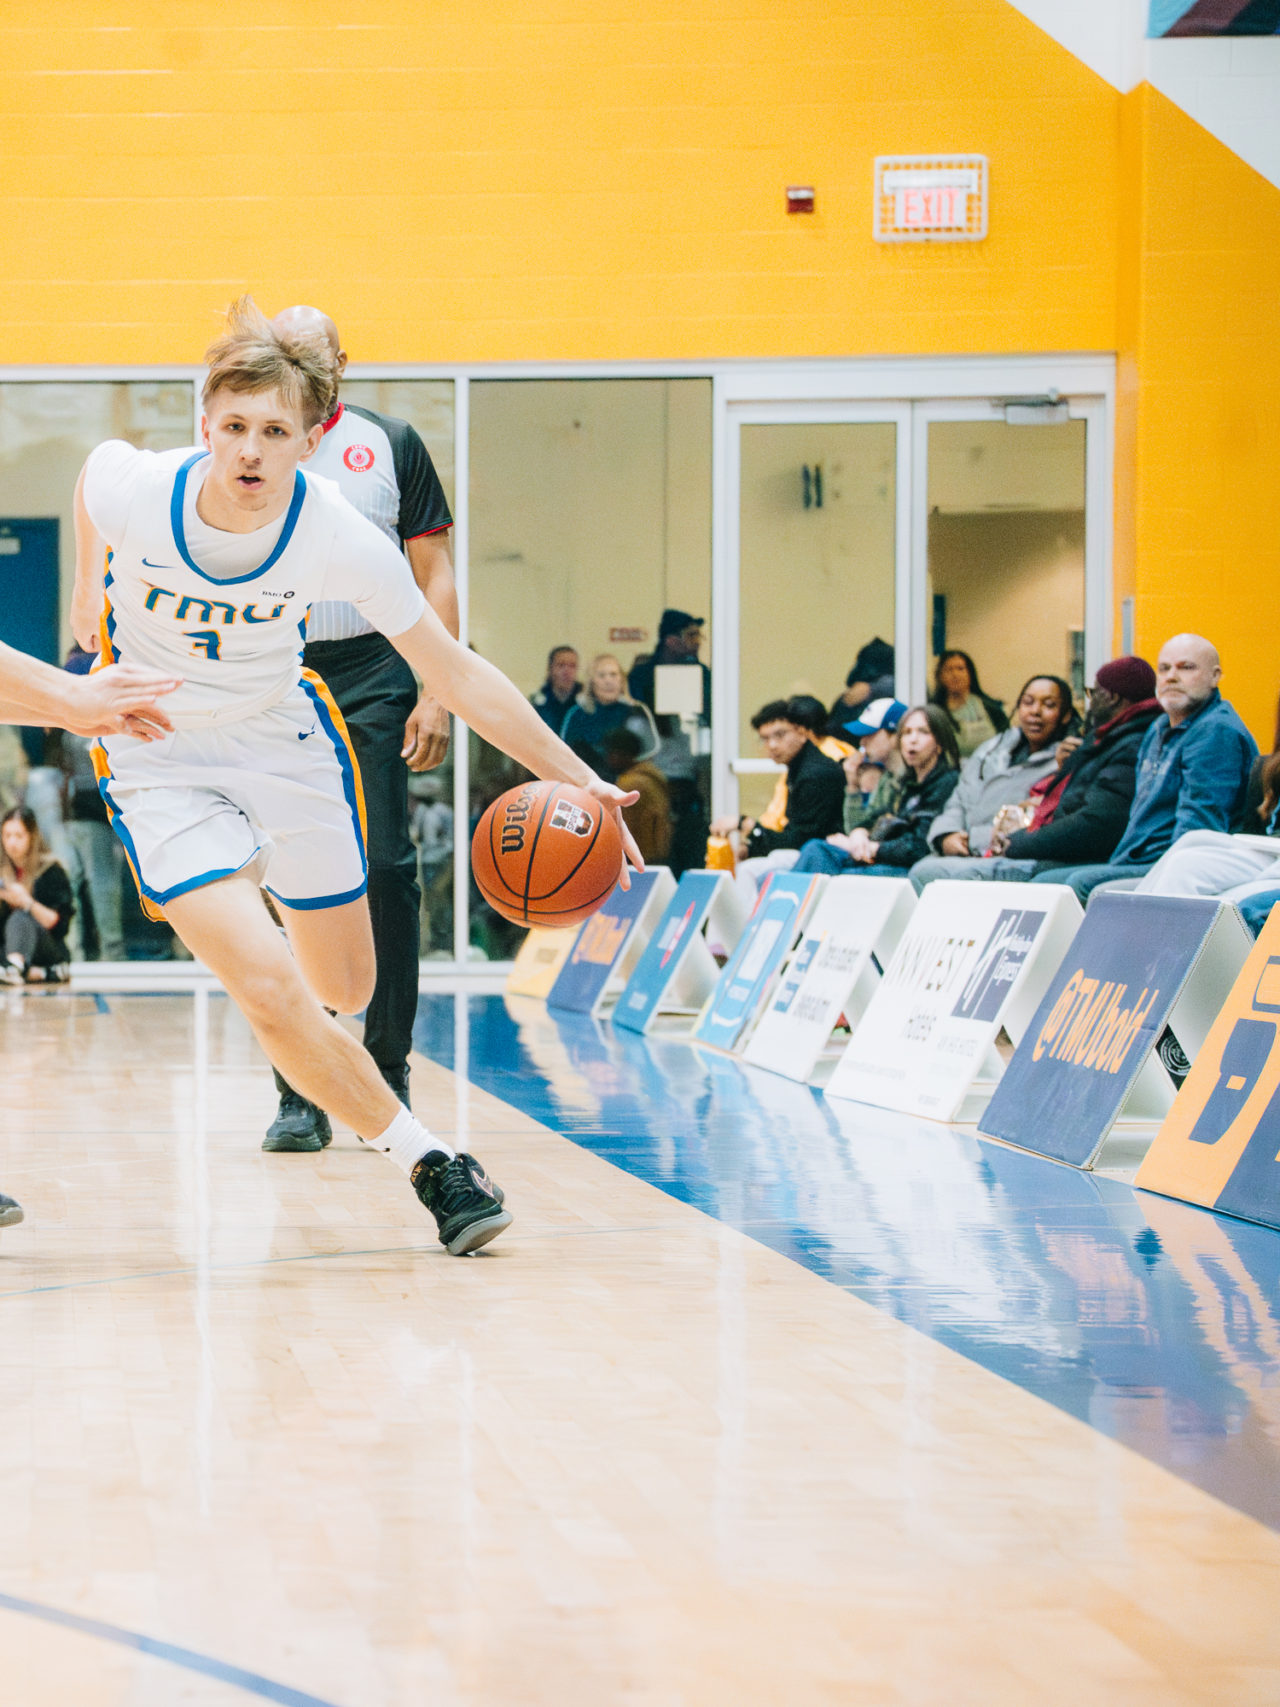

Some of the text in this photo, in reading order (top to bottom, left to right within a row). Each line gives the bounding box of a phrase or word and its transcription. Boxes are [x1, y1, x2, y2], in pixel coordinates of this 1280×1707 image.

[903, 187, 958, 226] EXIT
[140, 578, 287, 625] TMU
[181, 629, 222, 661] 3
[1032, 968, 1160, 1074] @TMUbold
